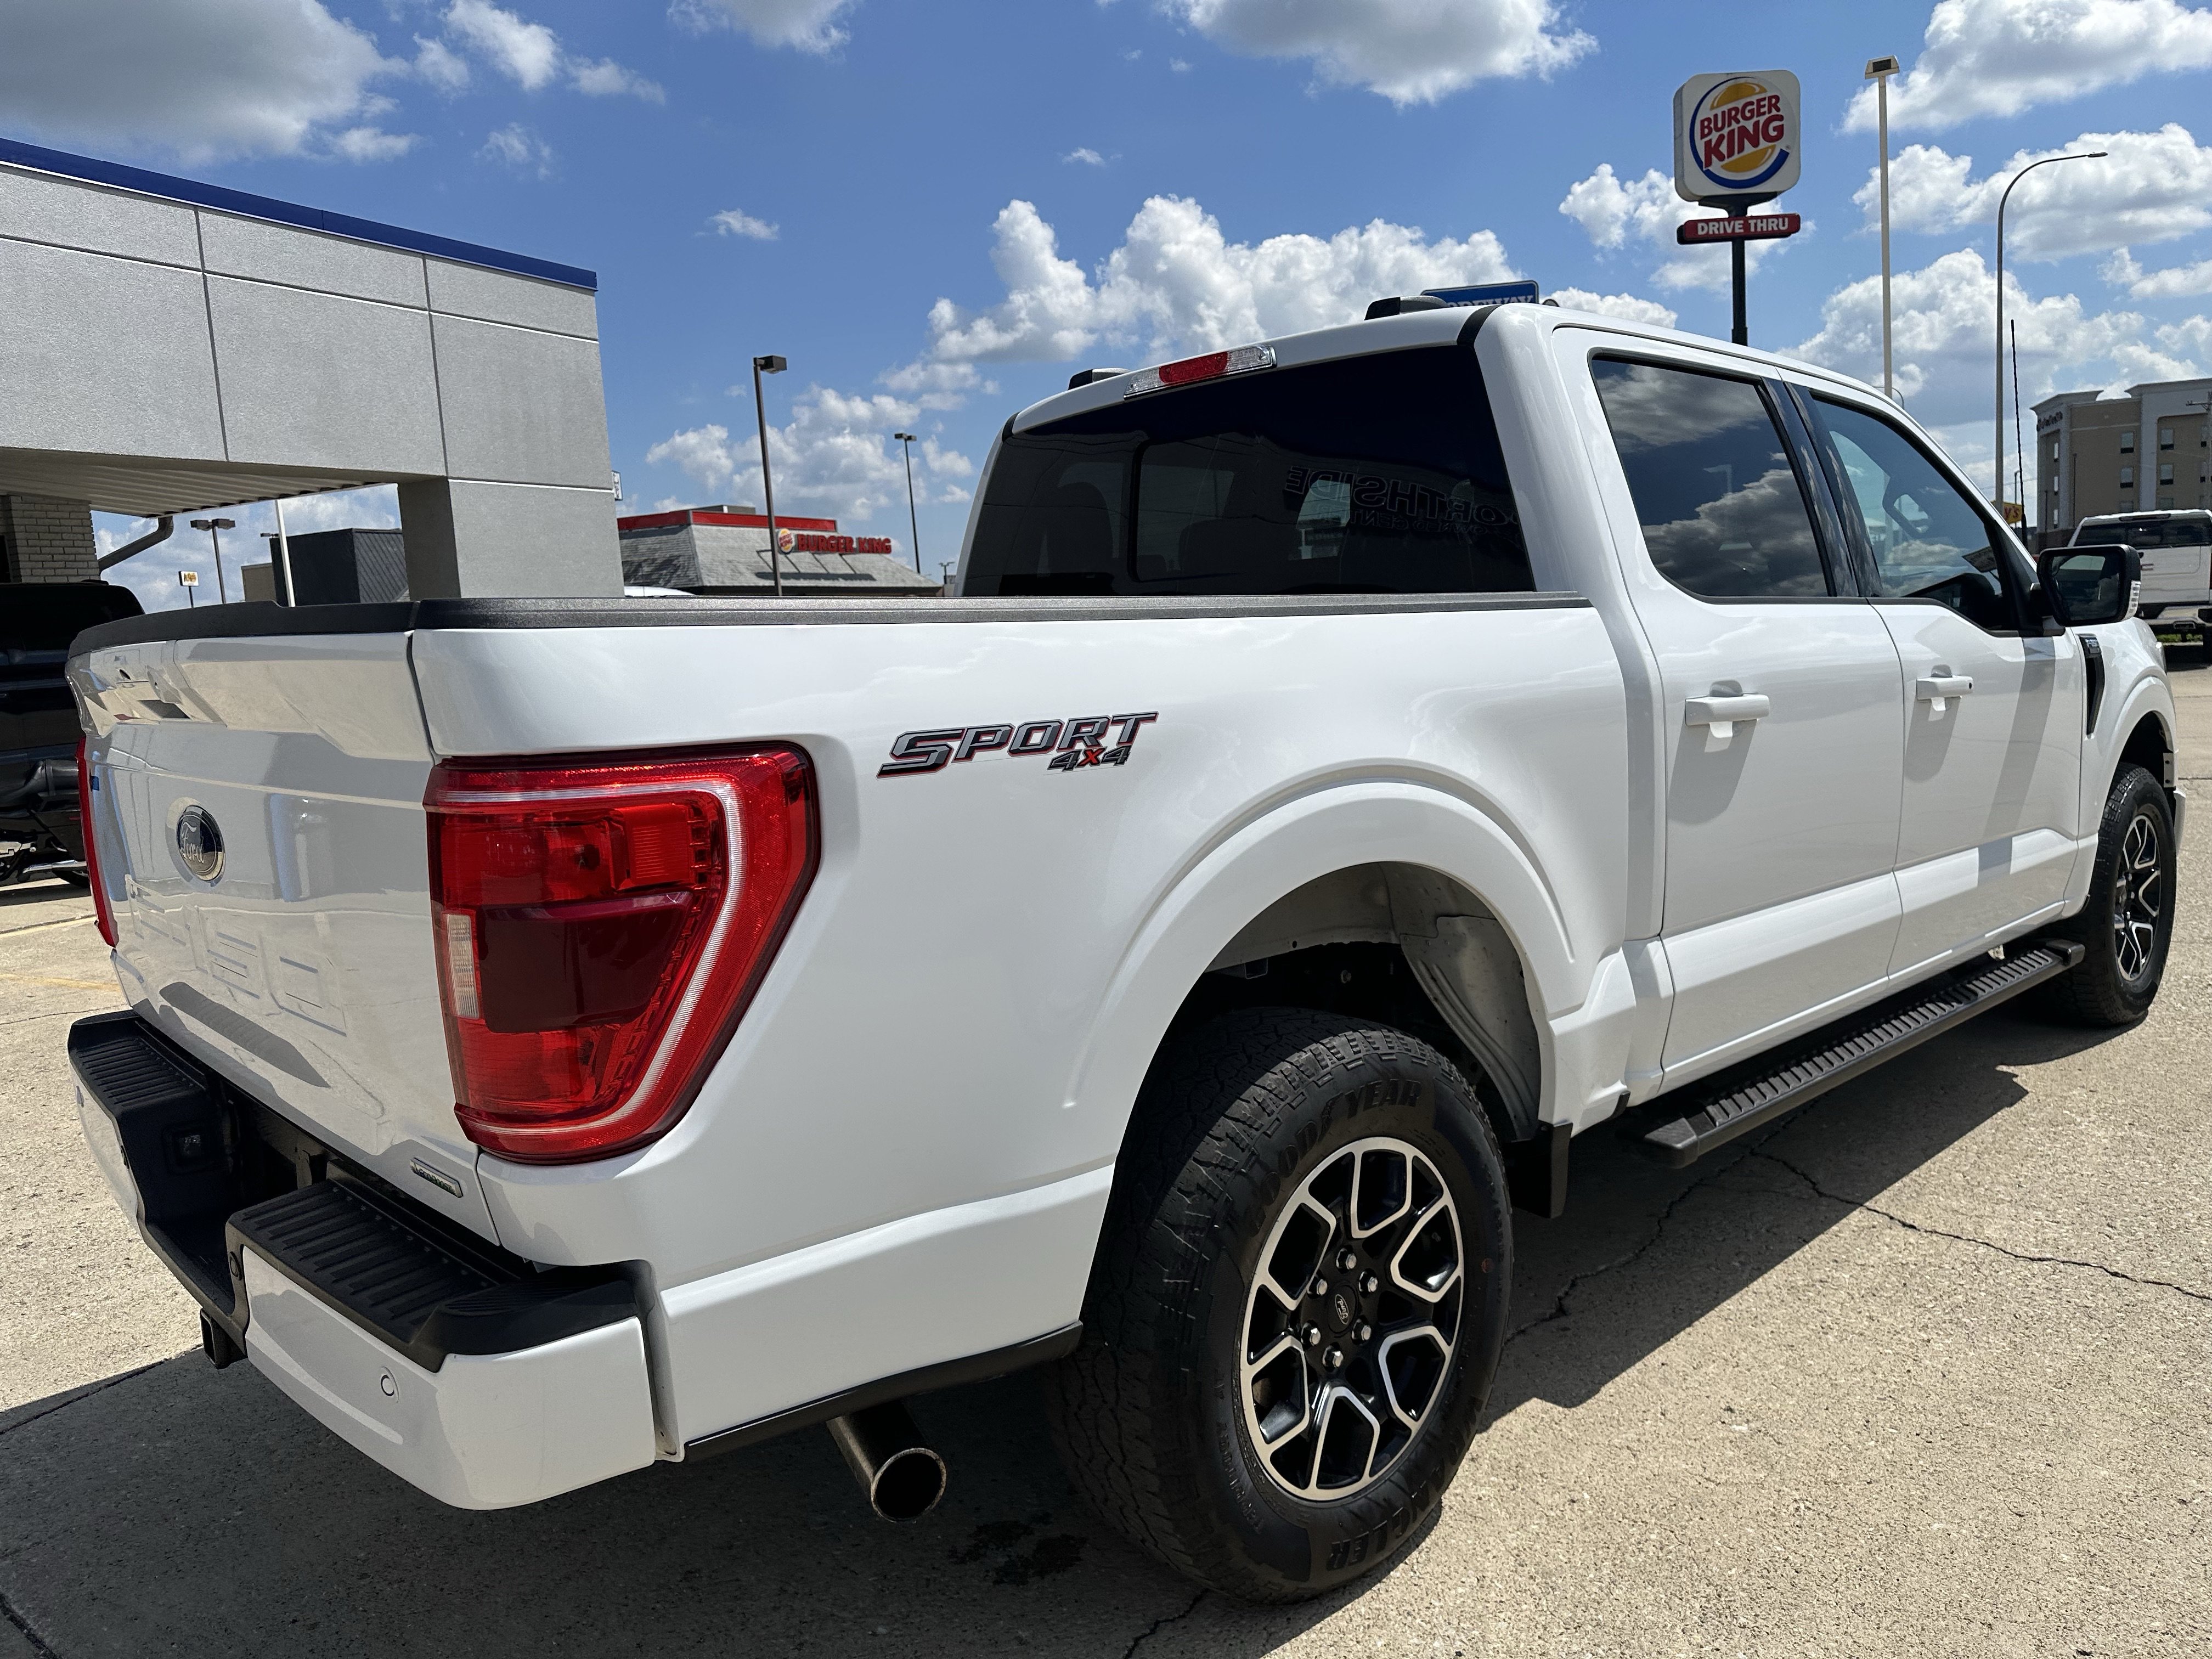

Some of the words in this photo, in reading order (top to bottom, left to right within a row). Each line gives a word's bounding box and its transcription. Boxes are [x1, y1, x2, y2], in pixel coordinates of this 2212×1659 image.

[1700, 94, 1781, 140] BURGER
[1702, 114, 1785, 169] KING
[1697, 220, 1744, 235] DRIVE
[1748, 218, 1788, 232] THRU
[797, 533, 854, 552] BURGER
[858, 537, 892, 554] KING
[876, 711, 1159, 780] SPORT
[180, 821, 206, 864] Ford
